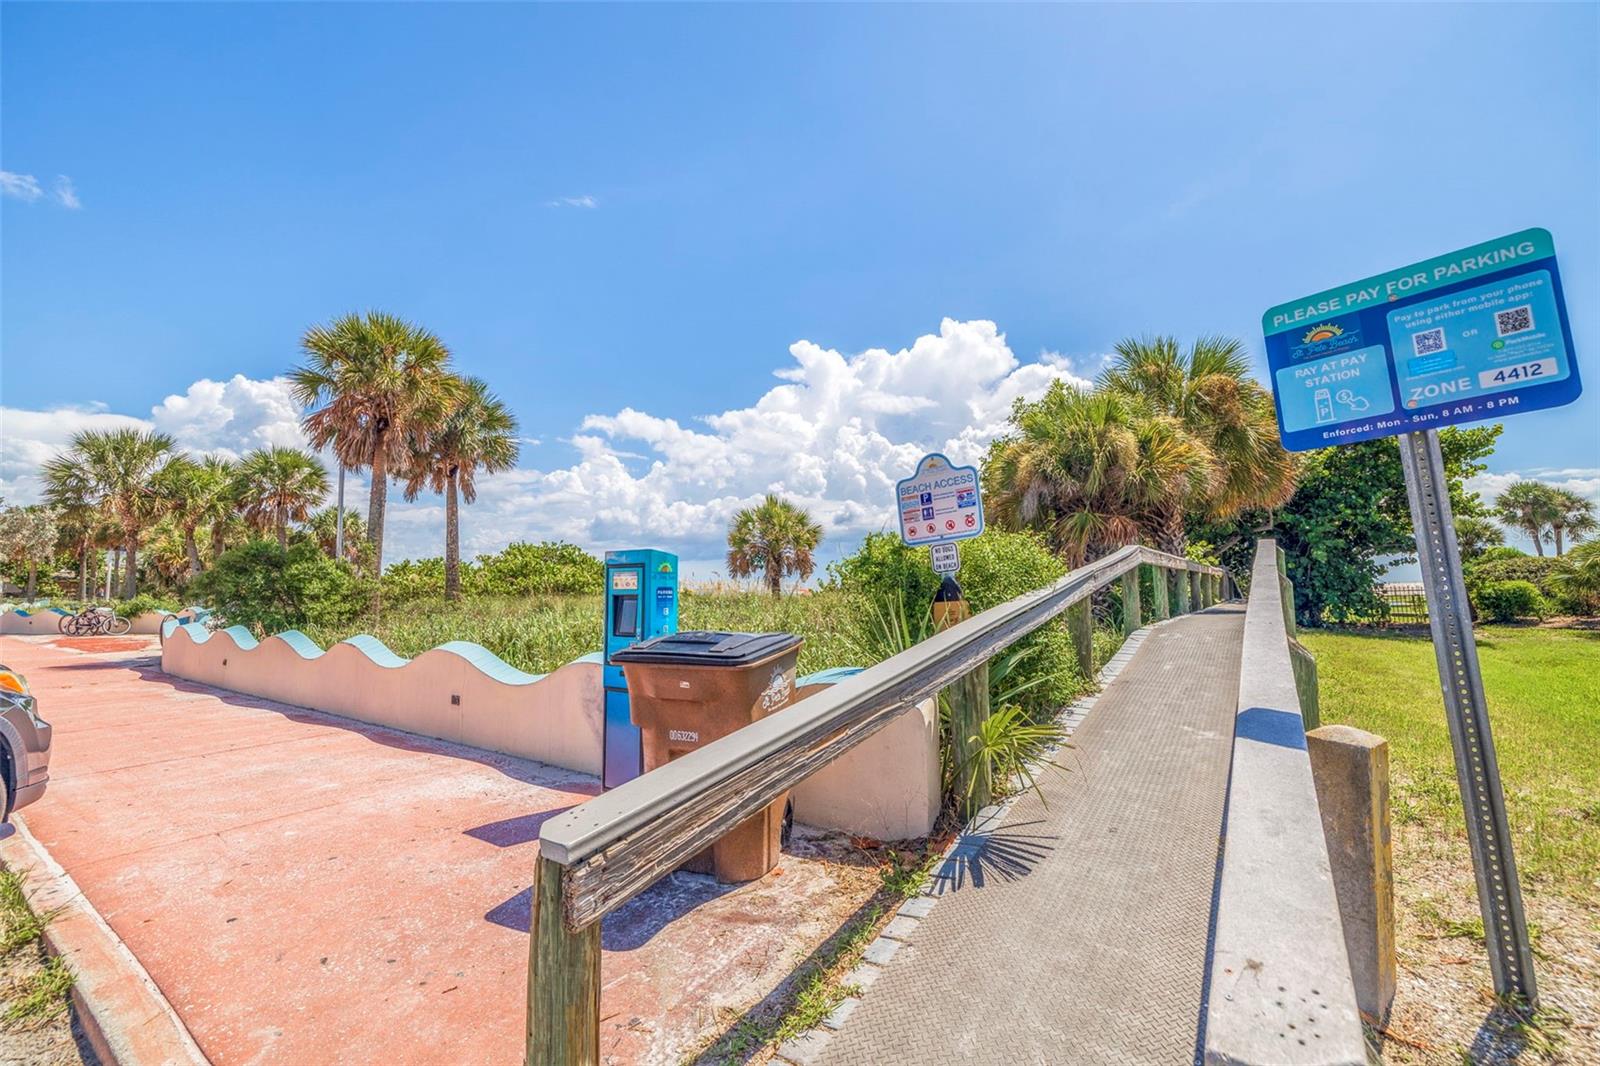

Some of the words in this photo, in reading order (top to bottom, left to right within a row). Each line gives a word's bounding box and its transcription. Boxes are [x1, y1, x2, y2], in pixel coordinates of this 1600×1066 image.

[1273, 297, 1341, 327] PLEASE
[1345, 286, 1380, 306] PAY
[1386, 272, 1428, 294] FOR
[1433, 242, 1535, 281] PARKING
[1394, 313, 1414, 323] Pay
[1414, 310, 1424, 318] to
[1427, 303, 1450, 315] park
[1452, 296, 1477, 307] from
[1480, 290, 1504, 301] your
[1507, 279, 1544, 294] phone
[1405, 317, 1432, 328] using
[1435, 308, 1466, 321] either
[1468, 297, 1505, 312] mobile
[1462, 329, 1478, 337] OR
[1295, 366, 1317, 378] PAY
[1321, 361, 1339, 373] AT
[1340, 353, 1368, 368] PAY
[1493, 363, 1543, 382] 4412
[1305, 368, 1361, 388] STATION
[1411, 377, 1473, 400] ZONE
[1323, 423, 1374, 439] Enforced:
[1377, 419, 1400, 429] Mon
[1412, 413, 1438, 423] Sun,
[1442, 409, 1450, 417] 8
[1454, 404, 1473, 415] AM
[1487, 401, 1495, 409] 8
[1499, 396, 1519, 407] PM
[900, 482, 931, 496] BEACH
[934, 474, 973, 489] ACCESS
[936, 554, 955, 562] ALLOWED
